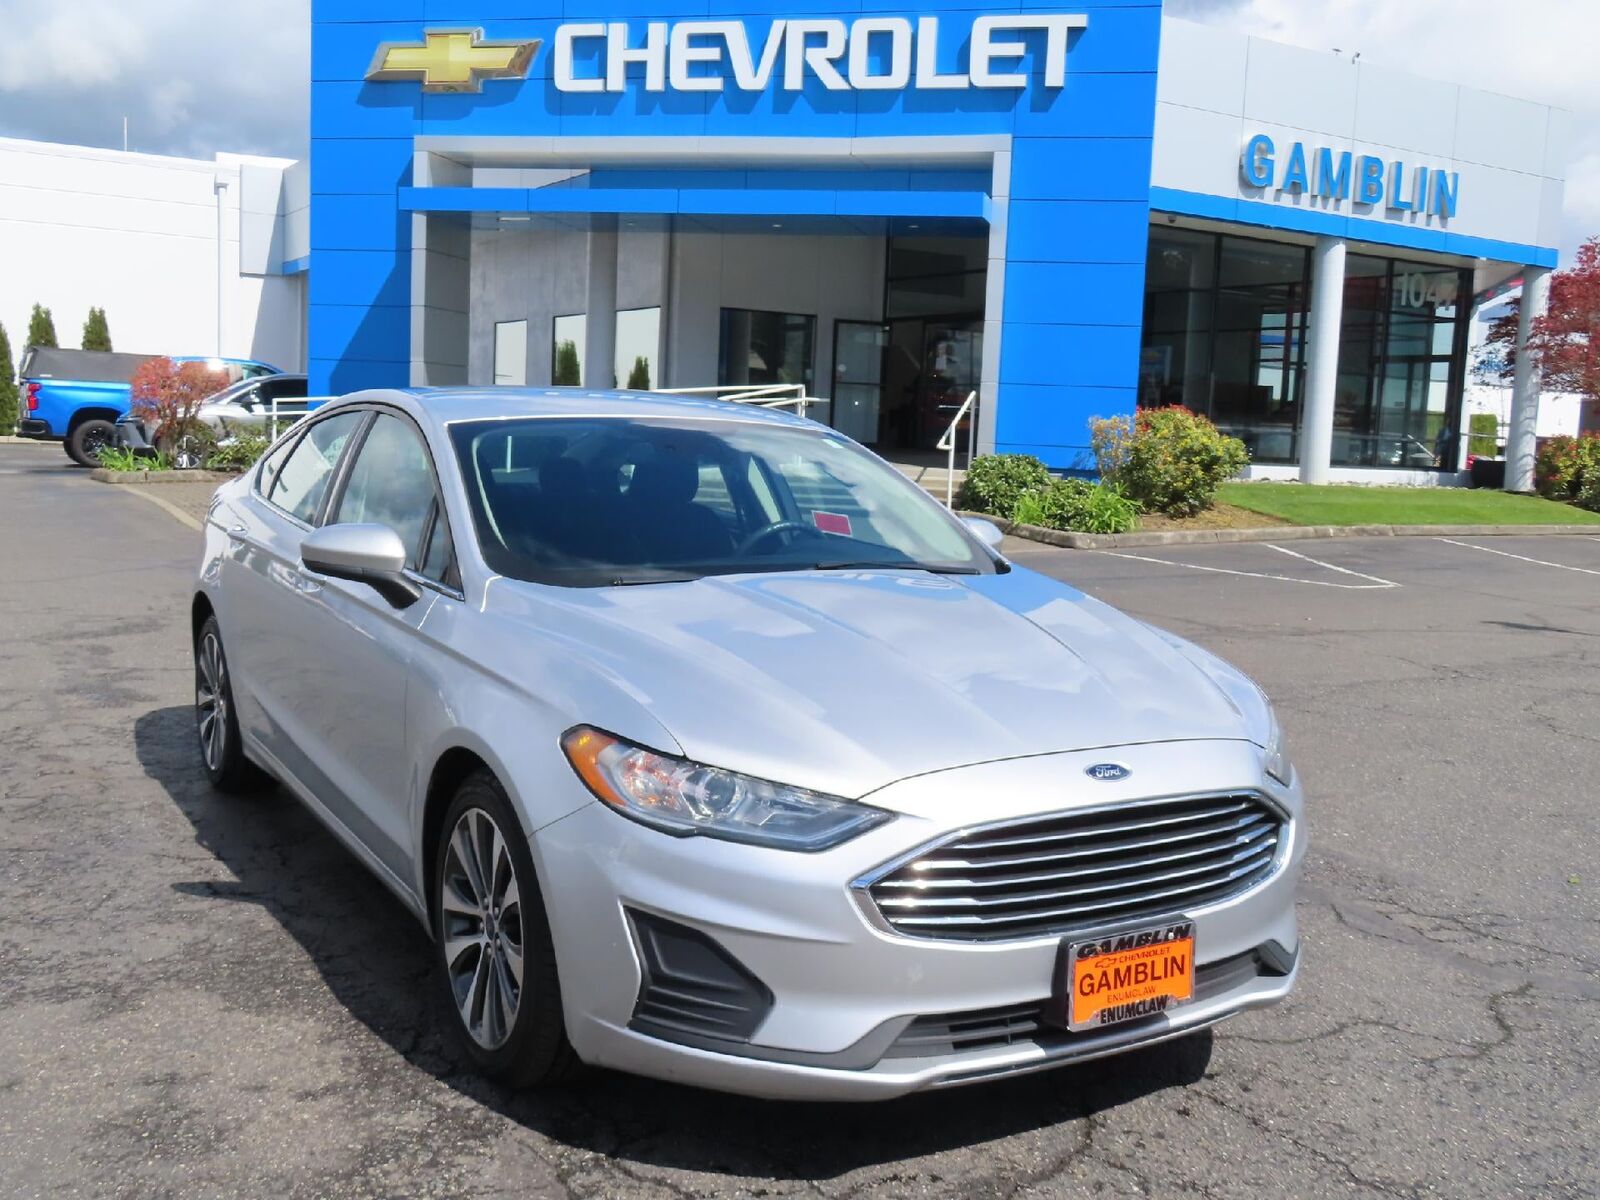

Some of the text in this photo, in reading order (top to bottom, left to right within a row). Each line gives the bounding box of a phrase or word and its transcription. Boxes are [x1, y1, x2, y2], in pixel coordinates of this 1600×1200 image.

[553, 14, 1088, 92] CHEVROLET
[1240, 134, 1459, 218] GAMBLIN
[1095, 765, 1121, 778] Ford
[1077, 923, 1191, 959] GAMBLIN
[1119, 946, 1171, 964] CHEVROLET
[1079, 954, 1185, 997] GAMBLIN
[1100, 994, 1169, 1024] ENUMCLAW
[1107, 985, 1156, 1004] ENUMCLAW
